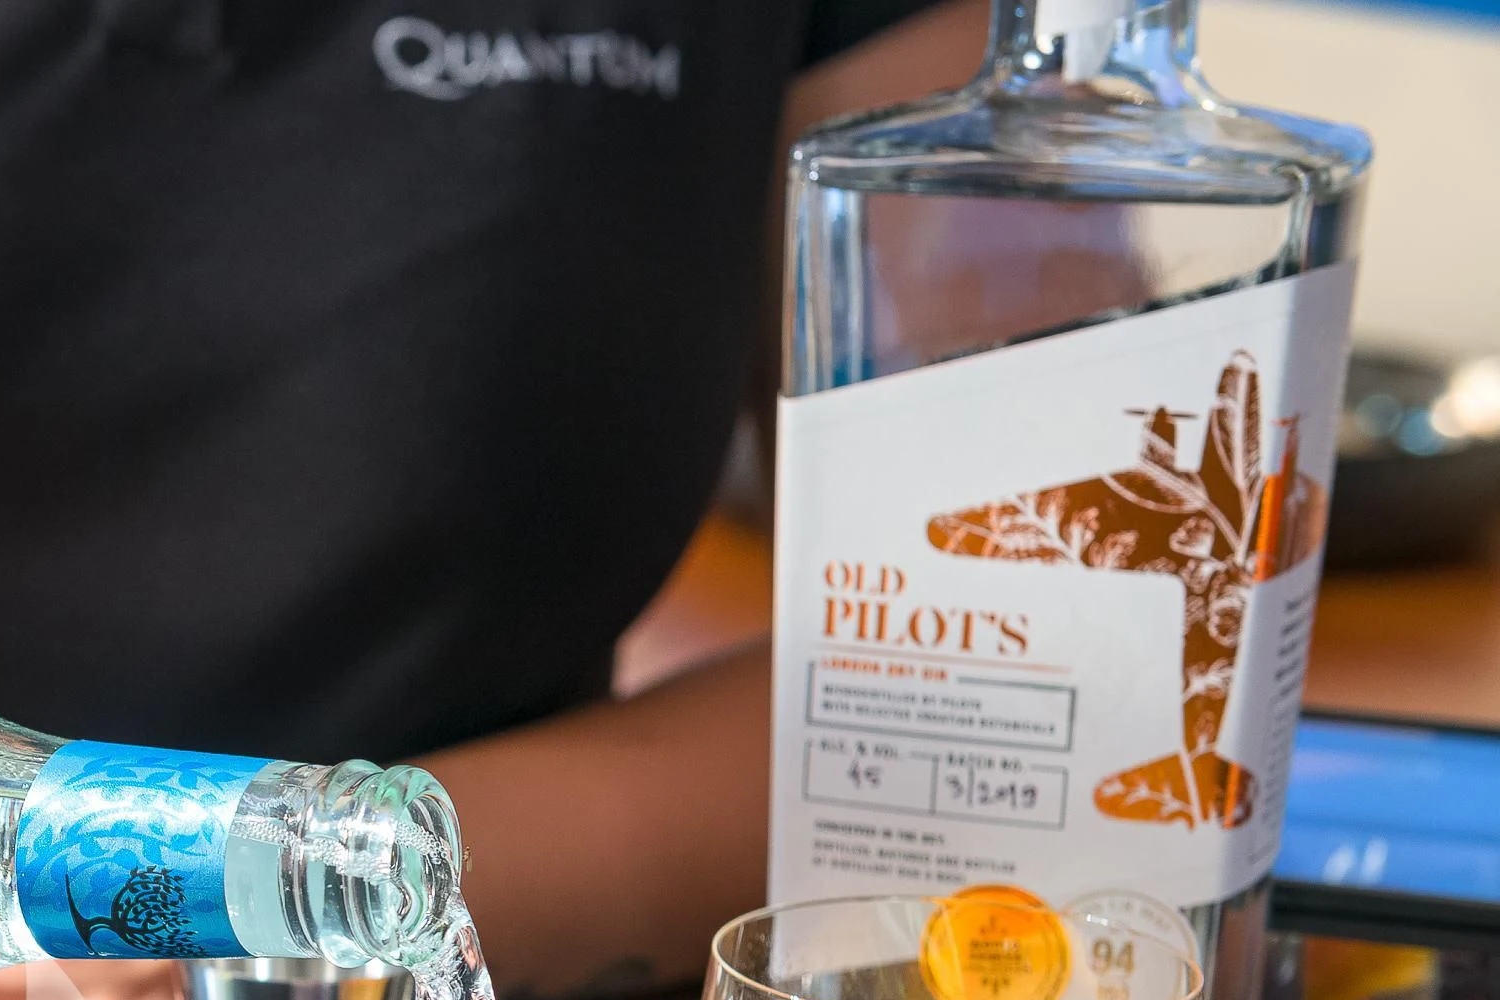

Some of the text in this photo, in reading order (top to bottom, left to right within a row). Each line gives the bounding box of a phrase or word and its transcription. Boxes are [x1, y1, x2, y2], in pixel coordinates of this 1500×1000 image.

[372, 15, 681, 99] QUANTUM
[823, 560, 906, 596] OLD
[822, 596, 1029, 656] PILOT'S
[820, 657, 949, 681] LONDON DRY GIN
[1092, 937, 1136, 978] 94
